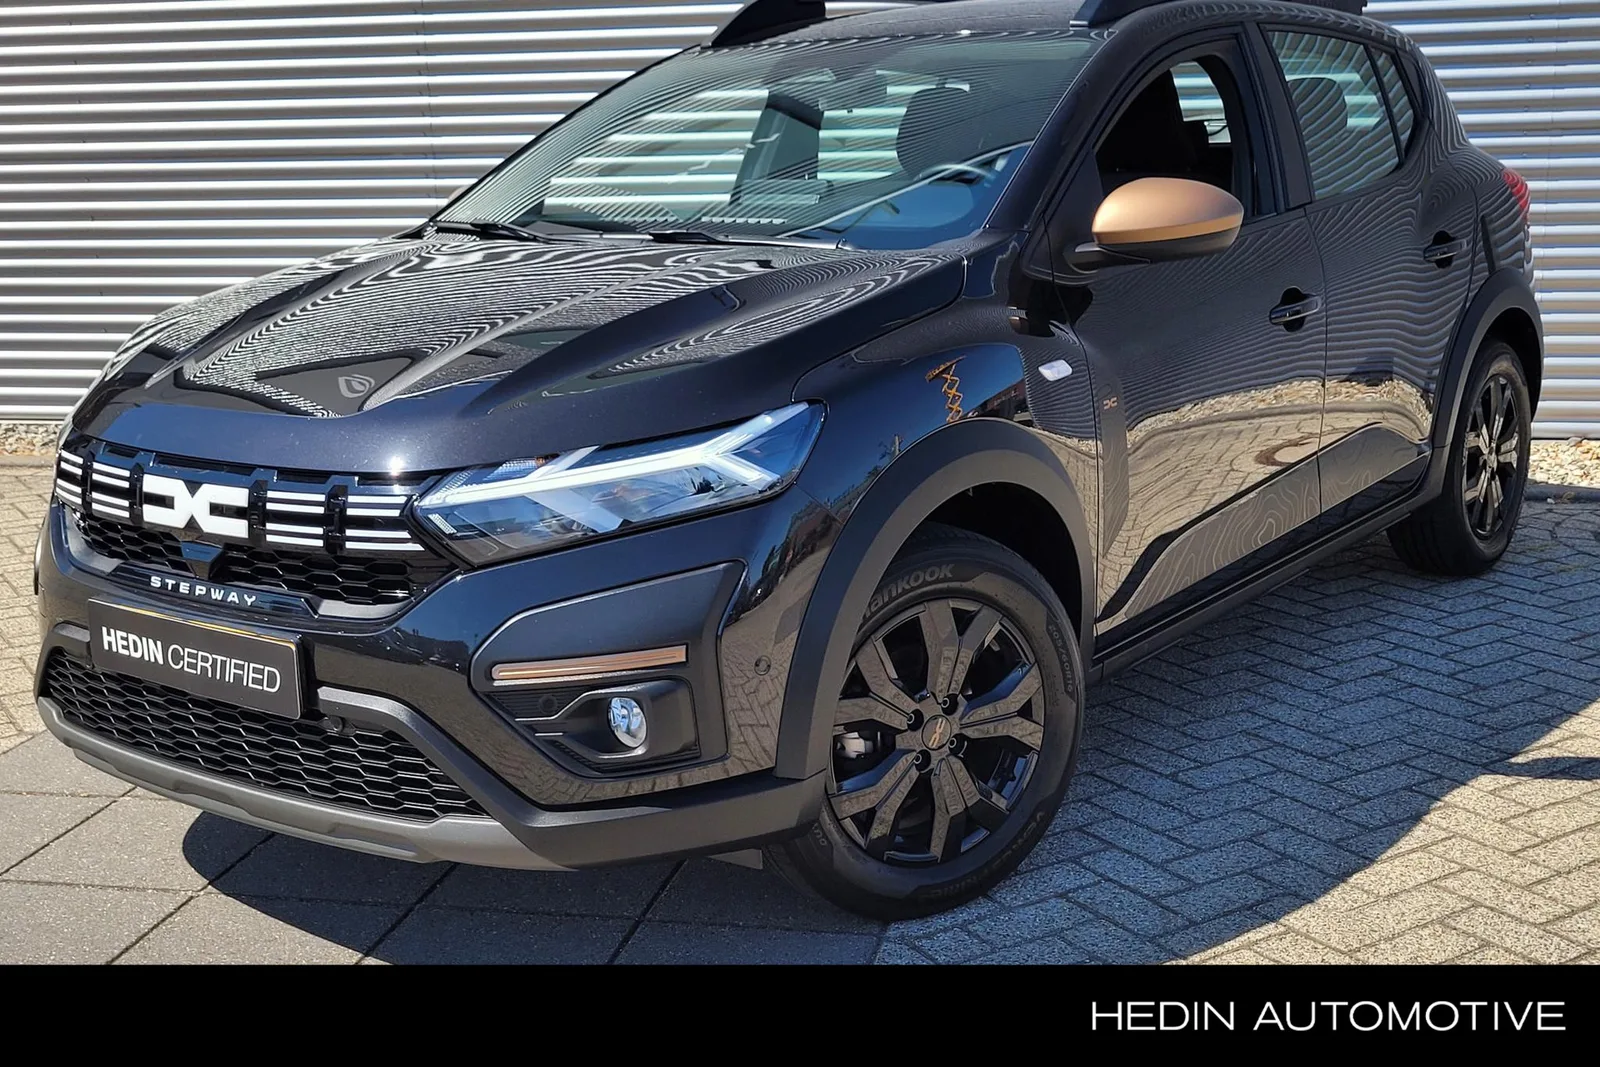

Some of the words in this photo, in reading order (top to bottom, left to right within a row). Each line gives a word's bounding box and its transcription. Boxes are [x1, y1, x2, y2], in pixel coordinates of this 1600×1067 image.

[150, 575, 257, 607] STEPWAY
[101, 625, 165, 666] HEDIN
[167, 644, 282, 693] CERTIFIED
